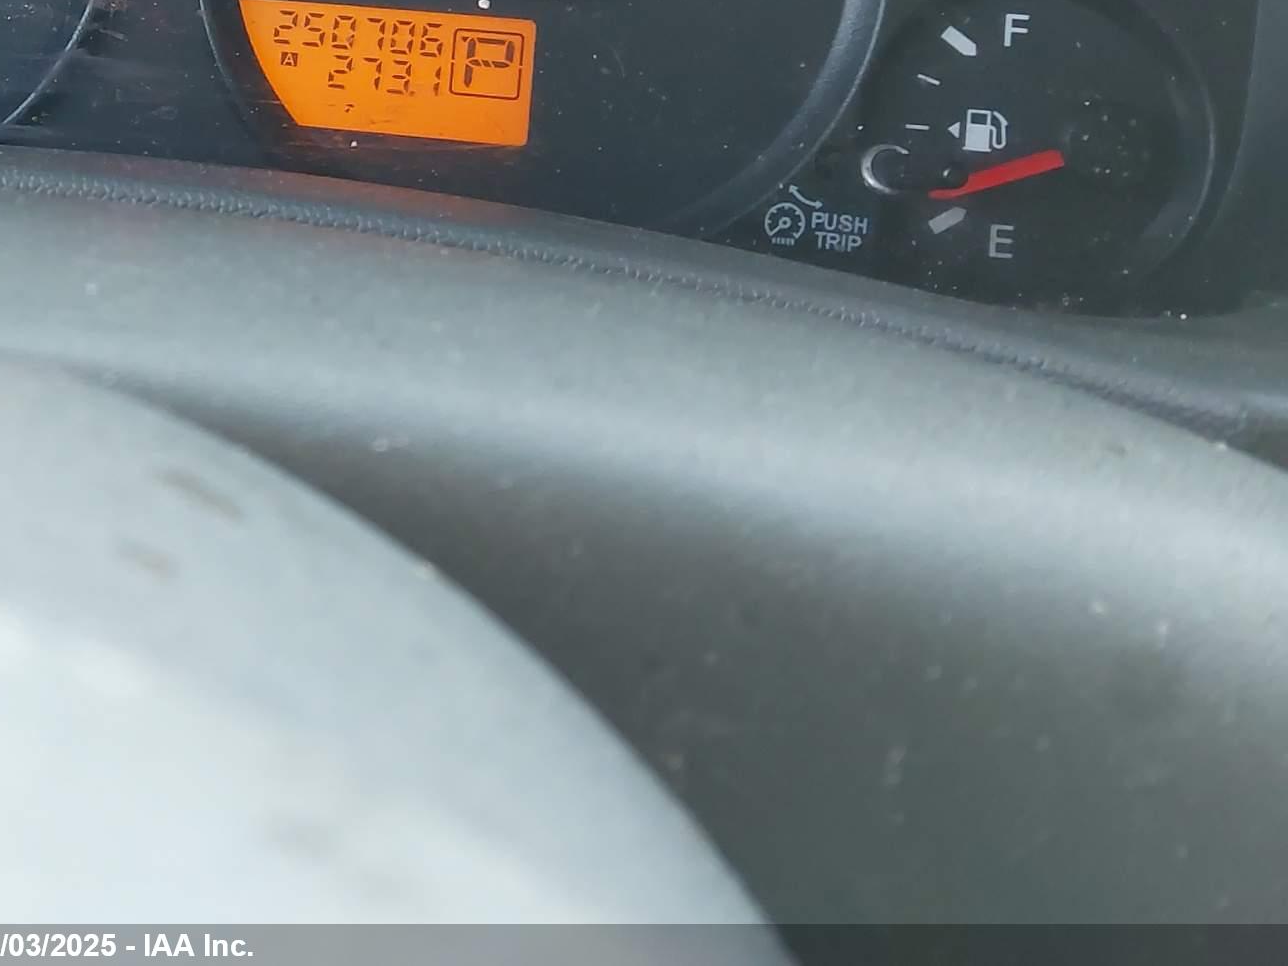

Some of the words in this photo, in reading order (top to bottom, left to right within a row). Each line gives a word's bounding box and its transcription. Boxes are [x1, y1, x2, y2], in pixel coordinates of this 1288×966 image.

[273, 10, 443, 58] 250706
[1004, 13, 1030, 47] F
[461, 36, 515, 88] P
[812, 212, 868, 235] PUSH
[815, 232, 862, 252] TRIP
[988, 225, 1015, 258] E
